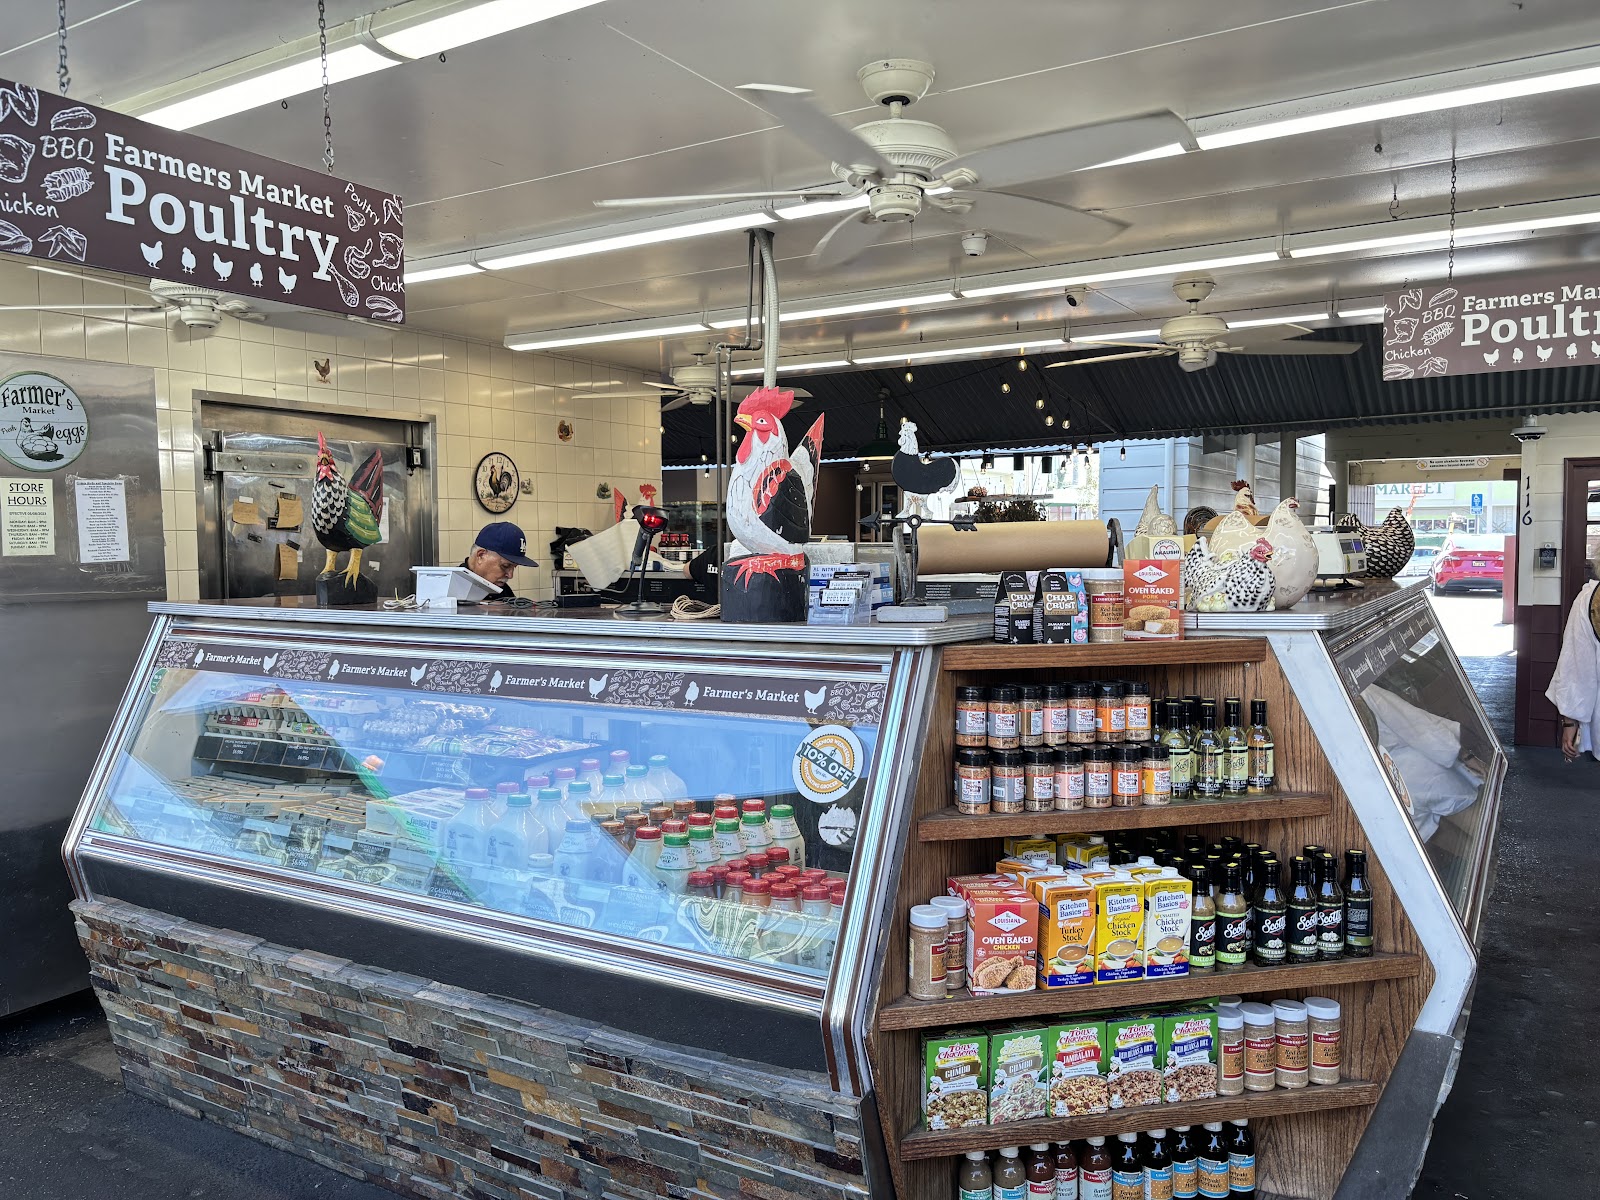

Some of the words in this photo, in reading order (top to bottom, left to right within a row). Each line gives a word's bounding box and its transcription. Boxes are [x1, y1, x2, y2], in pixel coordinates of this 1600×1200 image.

[39, 135, 95, 165] BBQ
[104, 132, 232, 190] Farmers
[238, 169, 335, 218] Market
[344, 182, 380, 226] Poultry
[103, 164, 340, 282] Poultry
[1462, 290, 1555, 313] Farmers
[1560, 284, 1600, 303] Ma
[1421, 304, 1456, 324] BBQ
[1384, 346, 1432, 362] Chicken
[1, 385, 74, 411] Farmer's
[22, 406, 56, 415] Market
[55, 425, 87, 446] eggs
[9, 482, 44, 492] STORE
[1375, 482, 1442, 495] MARET
[7, 496, 47, 505] HOURS
[1522, 475, 1533, 526] 116
[1128, 587, 1149, 595] OVEN
[1150, 587, 1175, 595] BAKED
[1010, 593, 1035, 602] CHAR
[1046, 593, 1075, 602] CHAR
[1010, 601, 1034, 610] CRUS
[1045, 601, 1076, 611] CRUST
[205, 652, 235, 664] Farmer's
[235, 654, 262, 666] Market
[341, 663, 376, 675] Farmer's
[377, 666, 408, 678] Market
[504, 674, 547, 687] Farmer's
[548, 677, 586, 690] Market
[702, 685, 753, 700] Farmer's
[755, 689, 800, 703] Market
[803, 744, 827, 768] 10%
[828, 762, 852, 782] OFF
[1108, 897, 1136, 907] Kitchen
[1157, 894, 1184, 903] Kitchen
[1059, 901, 1087, 911] Kitchen
[1108, 904, 1131, 913] Basics
[1157, 900, 1179, 910] Basics
[1060, 909, 1082, 918] Basics
[1107, 921, 1136, 930] Chicken
[1155, 917, 1184, 926] Chicken
[1060, 926, 1085, 935] Turkey
[1111, 928, 1132, 937] Stock
[1160, 924, 1180, 933] Stock
[981, 936, 1006, 945] OVEN
[1006, 936, 1034, 944] BAKED
[1062, 932, 1083, 942] Stock
[1126, 1024, 1149, 1033] Tony
[1184, 1021, 1206, 1029] Tony
[1069, 1028, 1093, 1038] Tony
[948, 1044, 972, 1053] Tony
[1063, 1048, 1095, 1063] JAMBALAYA
[945, 1064, 971, 1079] GUMBO
[1009, 1059, 1033, 1074] GUMBO
[1229, 1170, 1248, 1178] eriyaki
